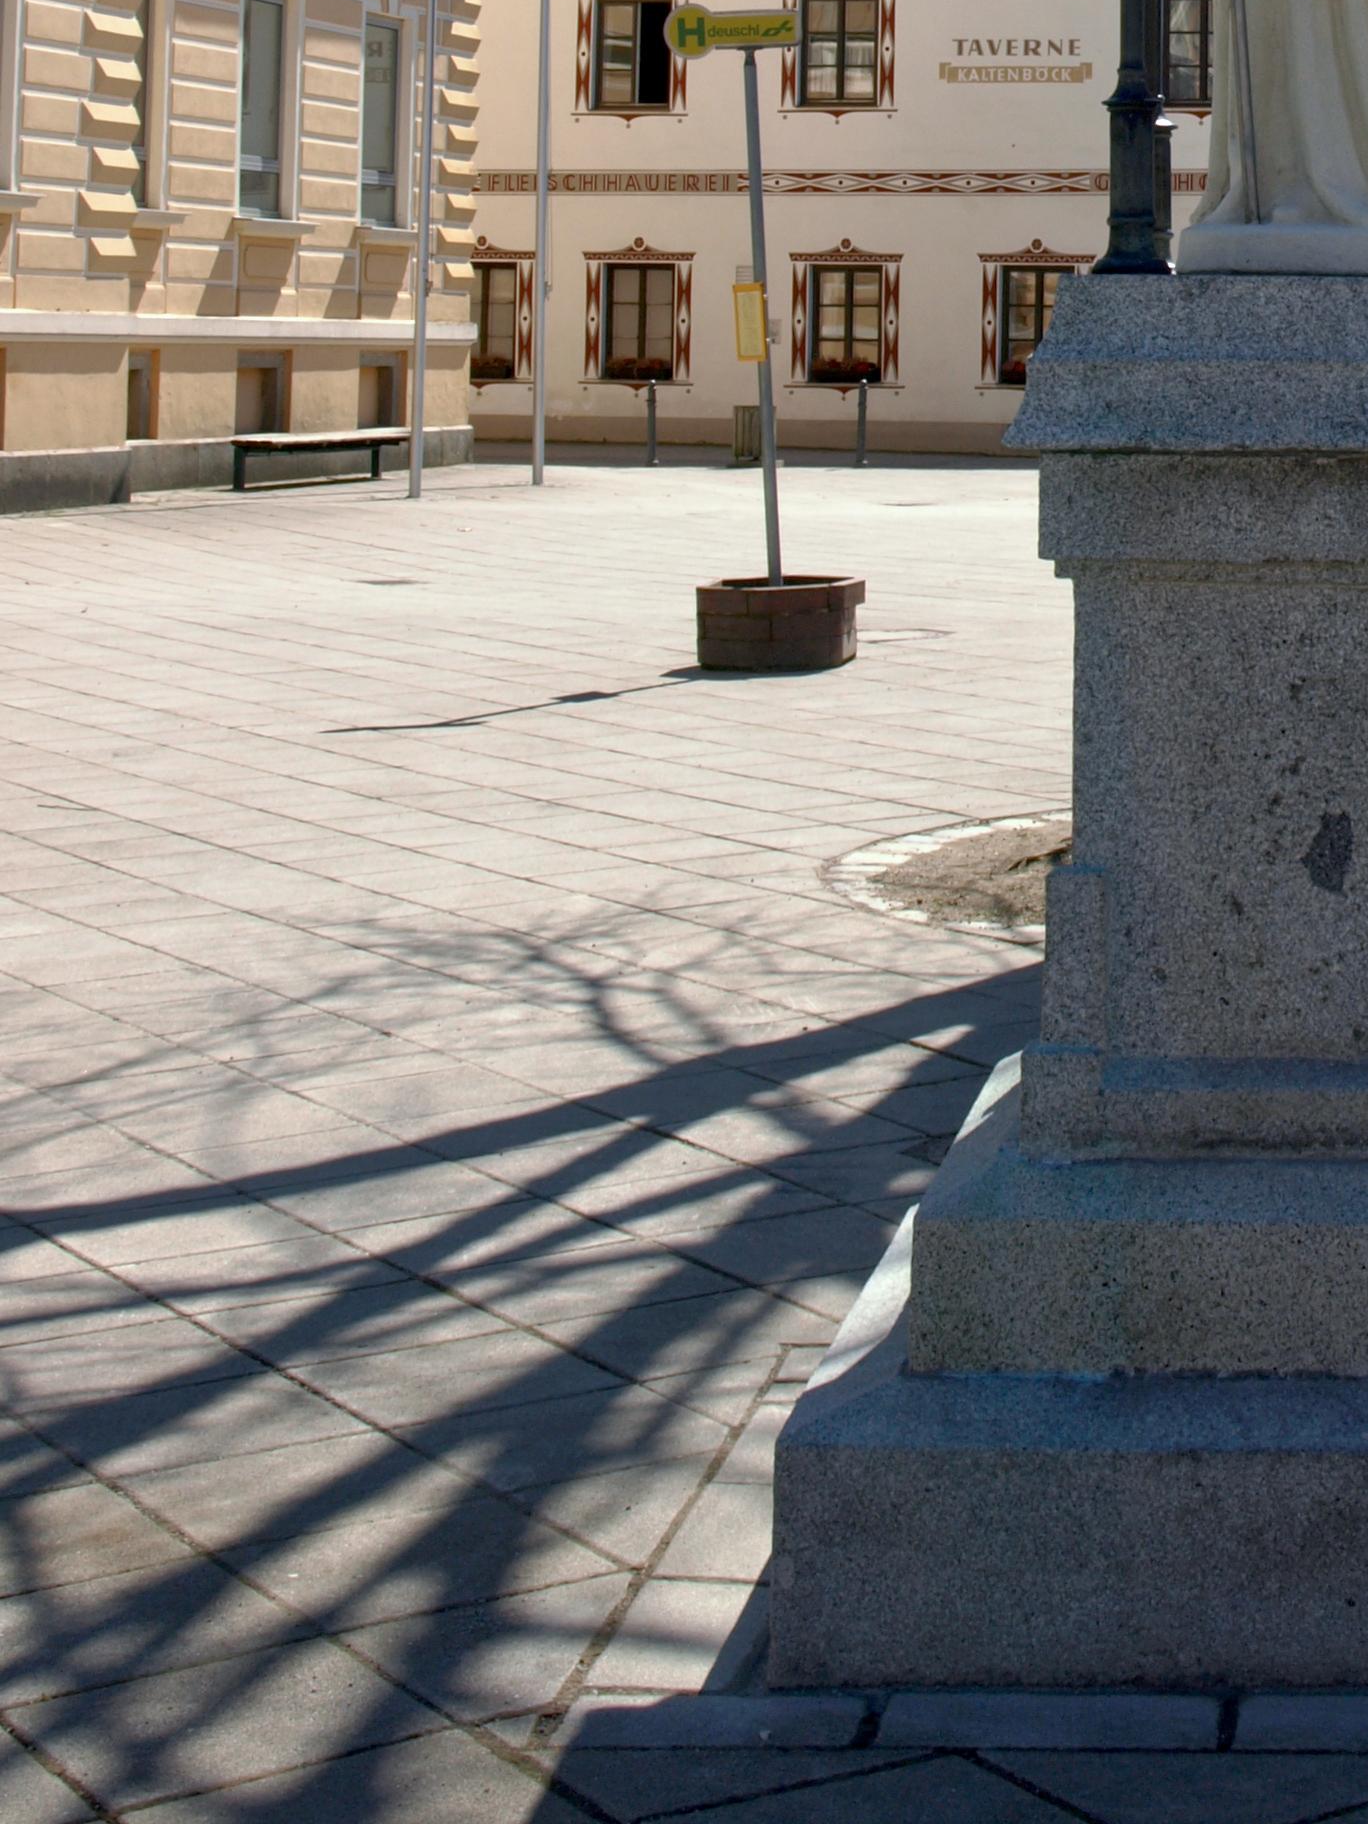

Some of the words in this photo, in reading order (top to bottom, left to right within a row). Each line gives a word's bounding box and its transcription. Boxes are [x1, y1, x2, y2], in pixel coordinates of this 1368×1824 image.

[677, 17, 706, 48] H
[707, 24, 760, 38] deuschl
[952, 38, 1082, 57] TAVERNE
[957, 65, 1072, 82] KALTENBÖCK
